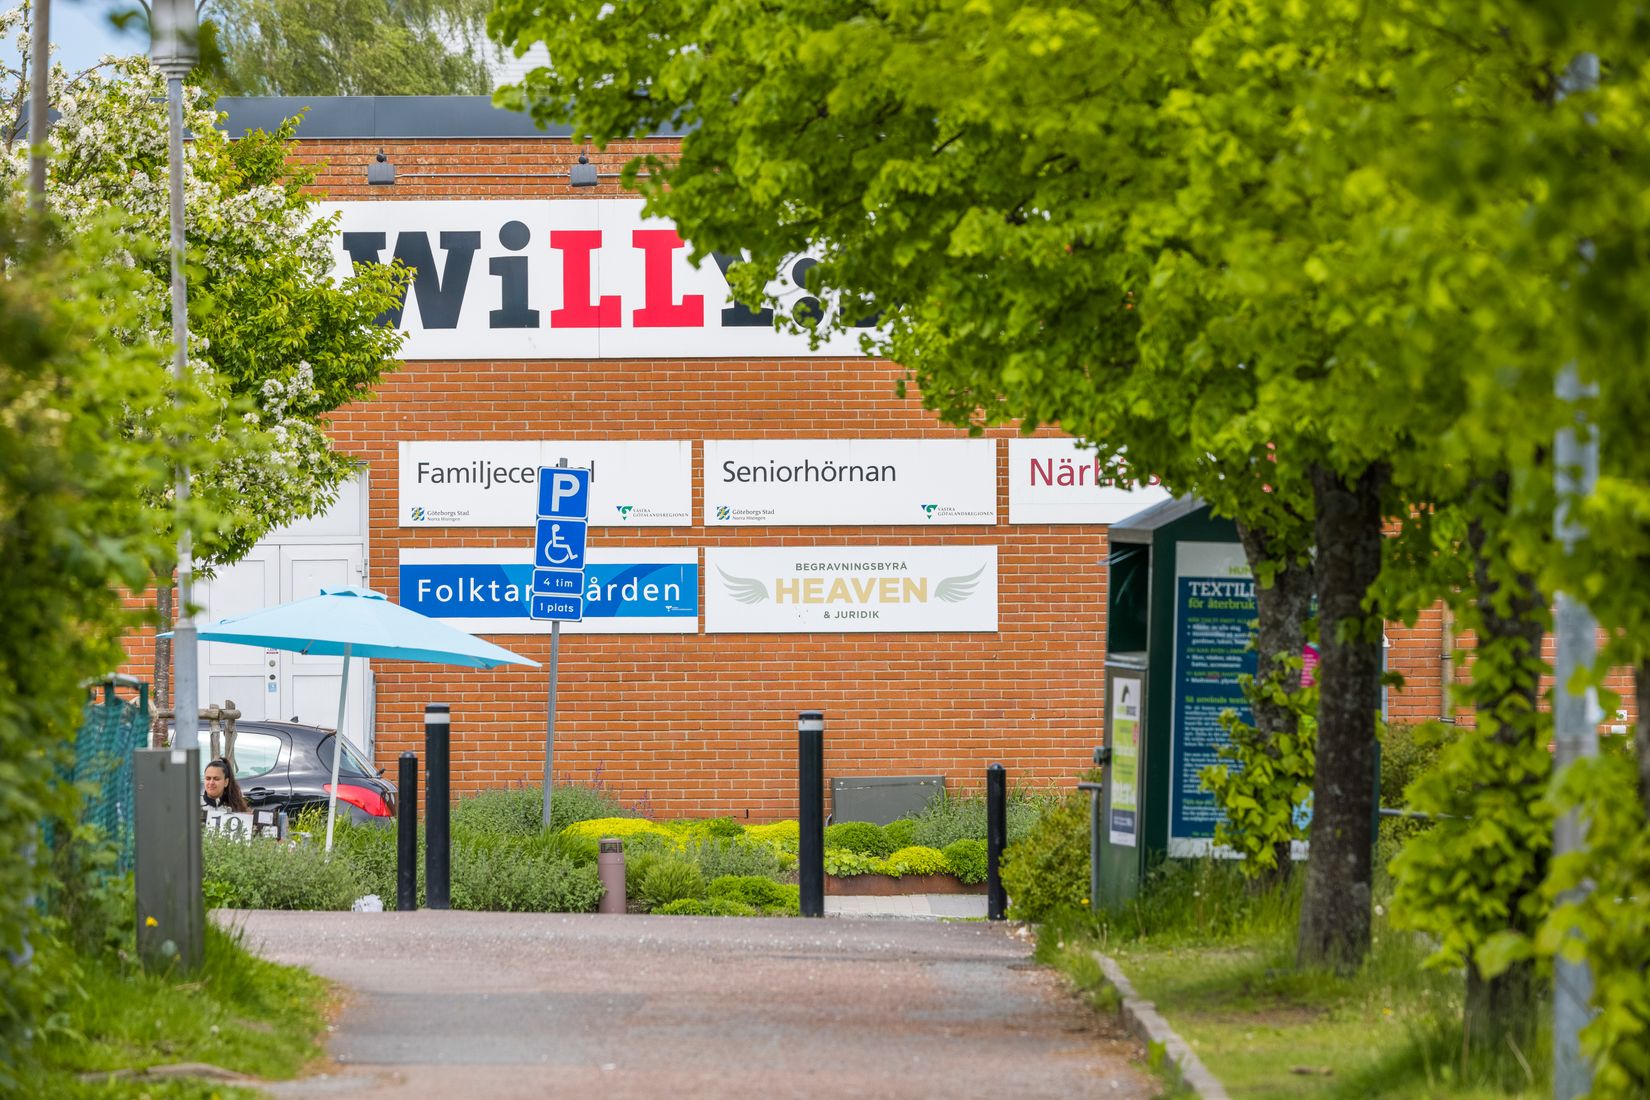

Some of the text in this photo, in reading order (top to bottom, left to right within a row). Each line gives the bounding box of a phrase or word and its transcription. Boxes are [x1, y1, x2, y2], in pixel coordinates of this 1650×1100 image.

[417, 460, 595, 489] Familjecel
[723, 460, 896, 483] Seniorhörnan
[551, 473, 580, 512] P
[427, 509, 456, 517] Göteborgs
[732, 508, 761, 516] Göteborgs
[795, 561, 907, 572] BEGRAVNINGSBYRÅ
[418, 576, 680, 602] Folktaården
[543, 577, 573, 588] 4 tim
[1188, 581, 1257, 597] TEXTILI
[775, 577, 928, 604] HEAVEN
[540, 602, 574, 614] 1 plats
[823, 610, 879, 619] & JURIDIK
